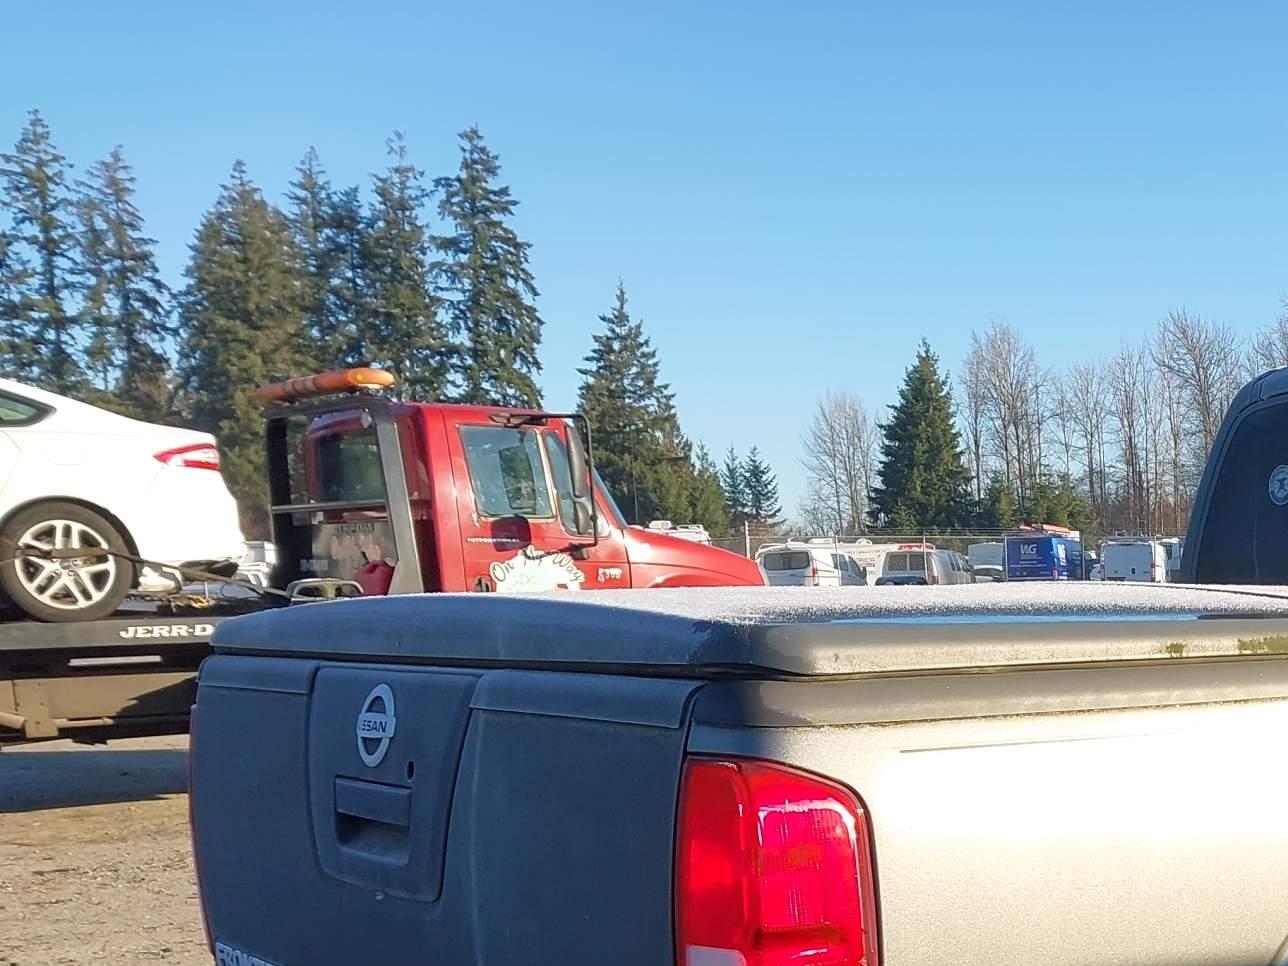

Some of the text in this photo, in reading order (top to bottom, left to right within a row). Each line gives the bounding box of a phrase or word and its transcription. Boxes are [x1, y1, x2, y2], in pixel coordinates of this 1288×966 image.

[491, 561, 514, 582] On
[552, 553, 582, 582] Way
[119, 623, 215, 639] JERR-D
